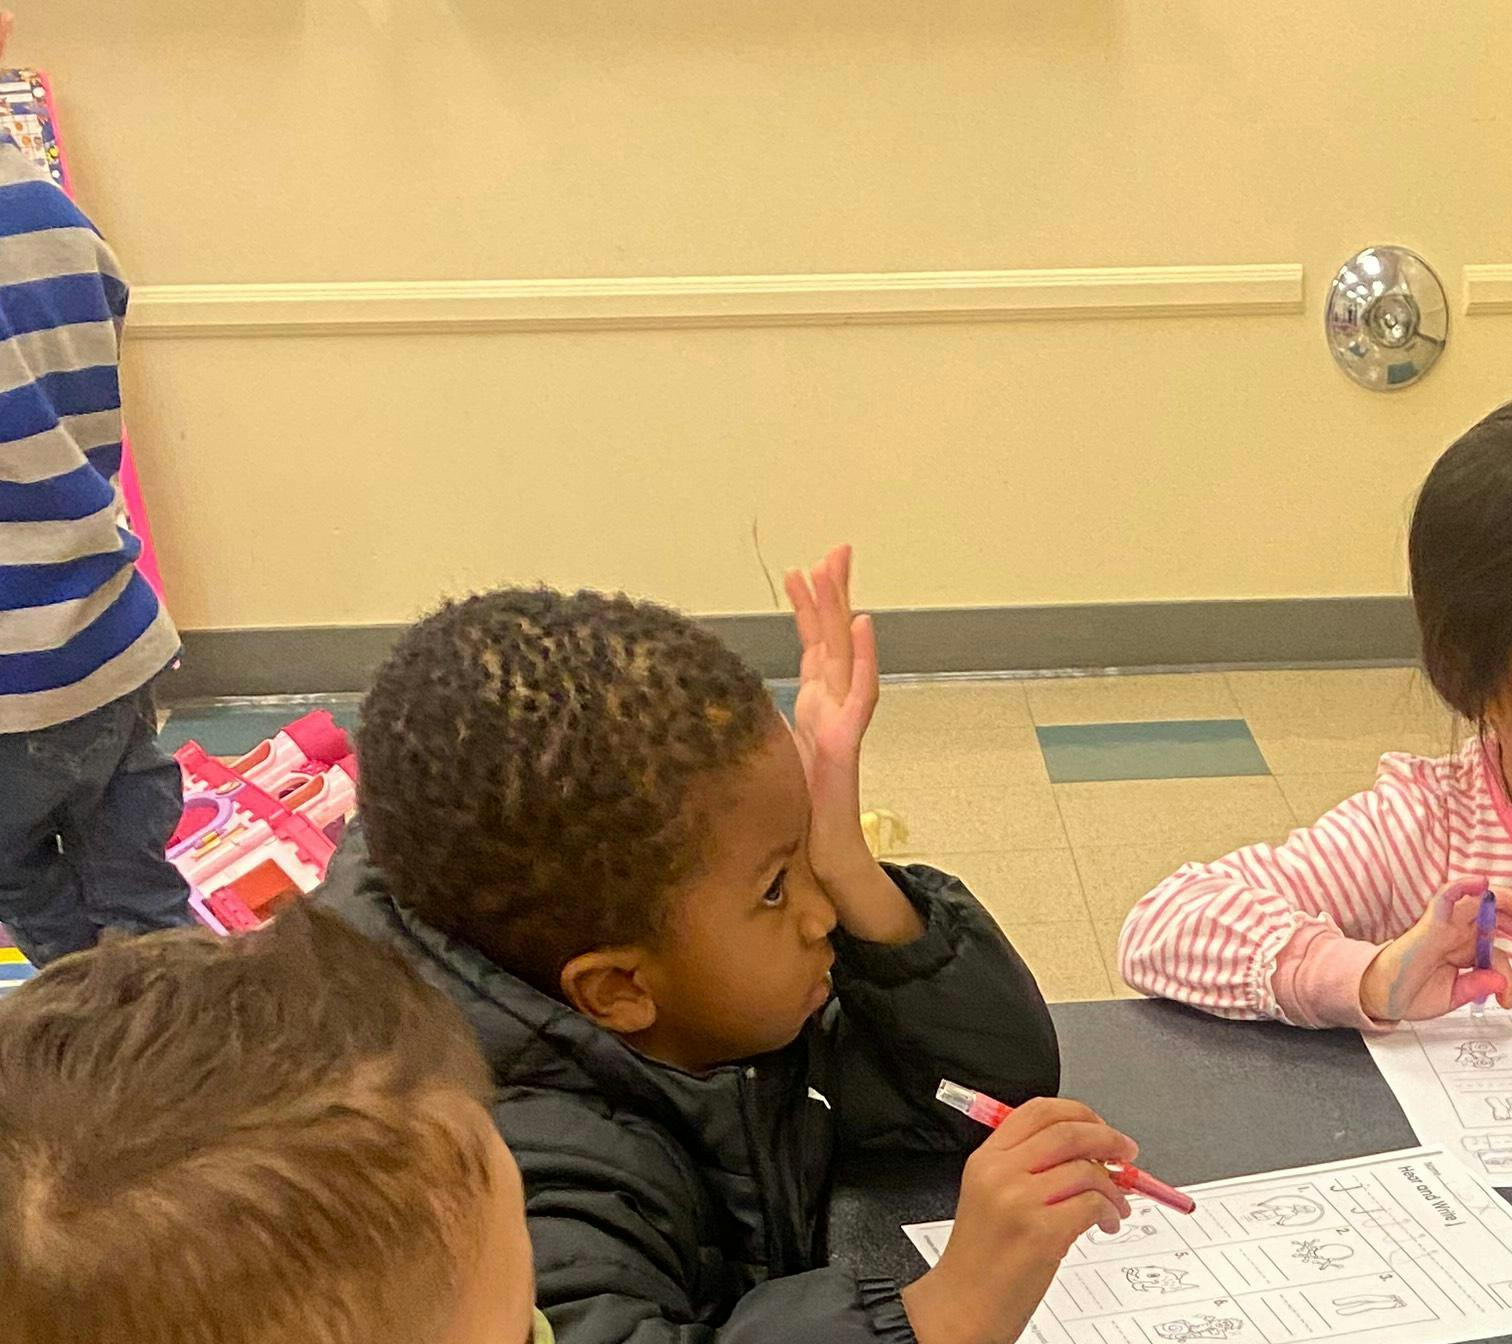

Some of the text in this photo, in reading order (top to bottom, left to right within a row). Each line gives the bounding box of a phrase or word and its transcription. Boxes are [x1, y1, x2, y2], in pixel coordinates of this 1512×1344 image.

[1399, 1165, 1423, 1184] Hear
[1416, 1182, 1440, 1202] and
[1432, 1196, 1458, 1222] Write
